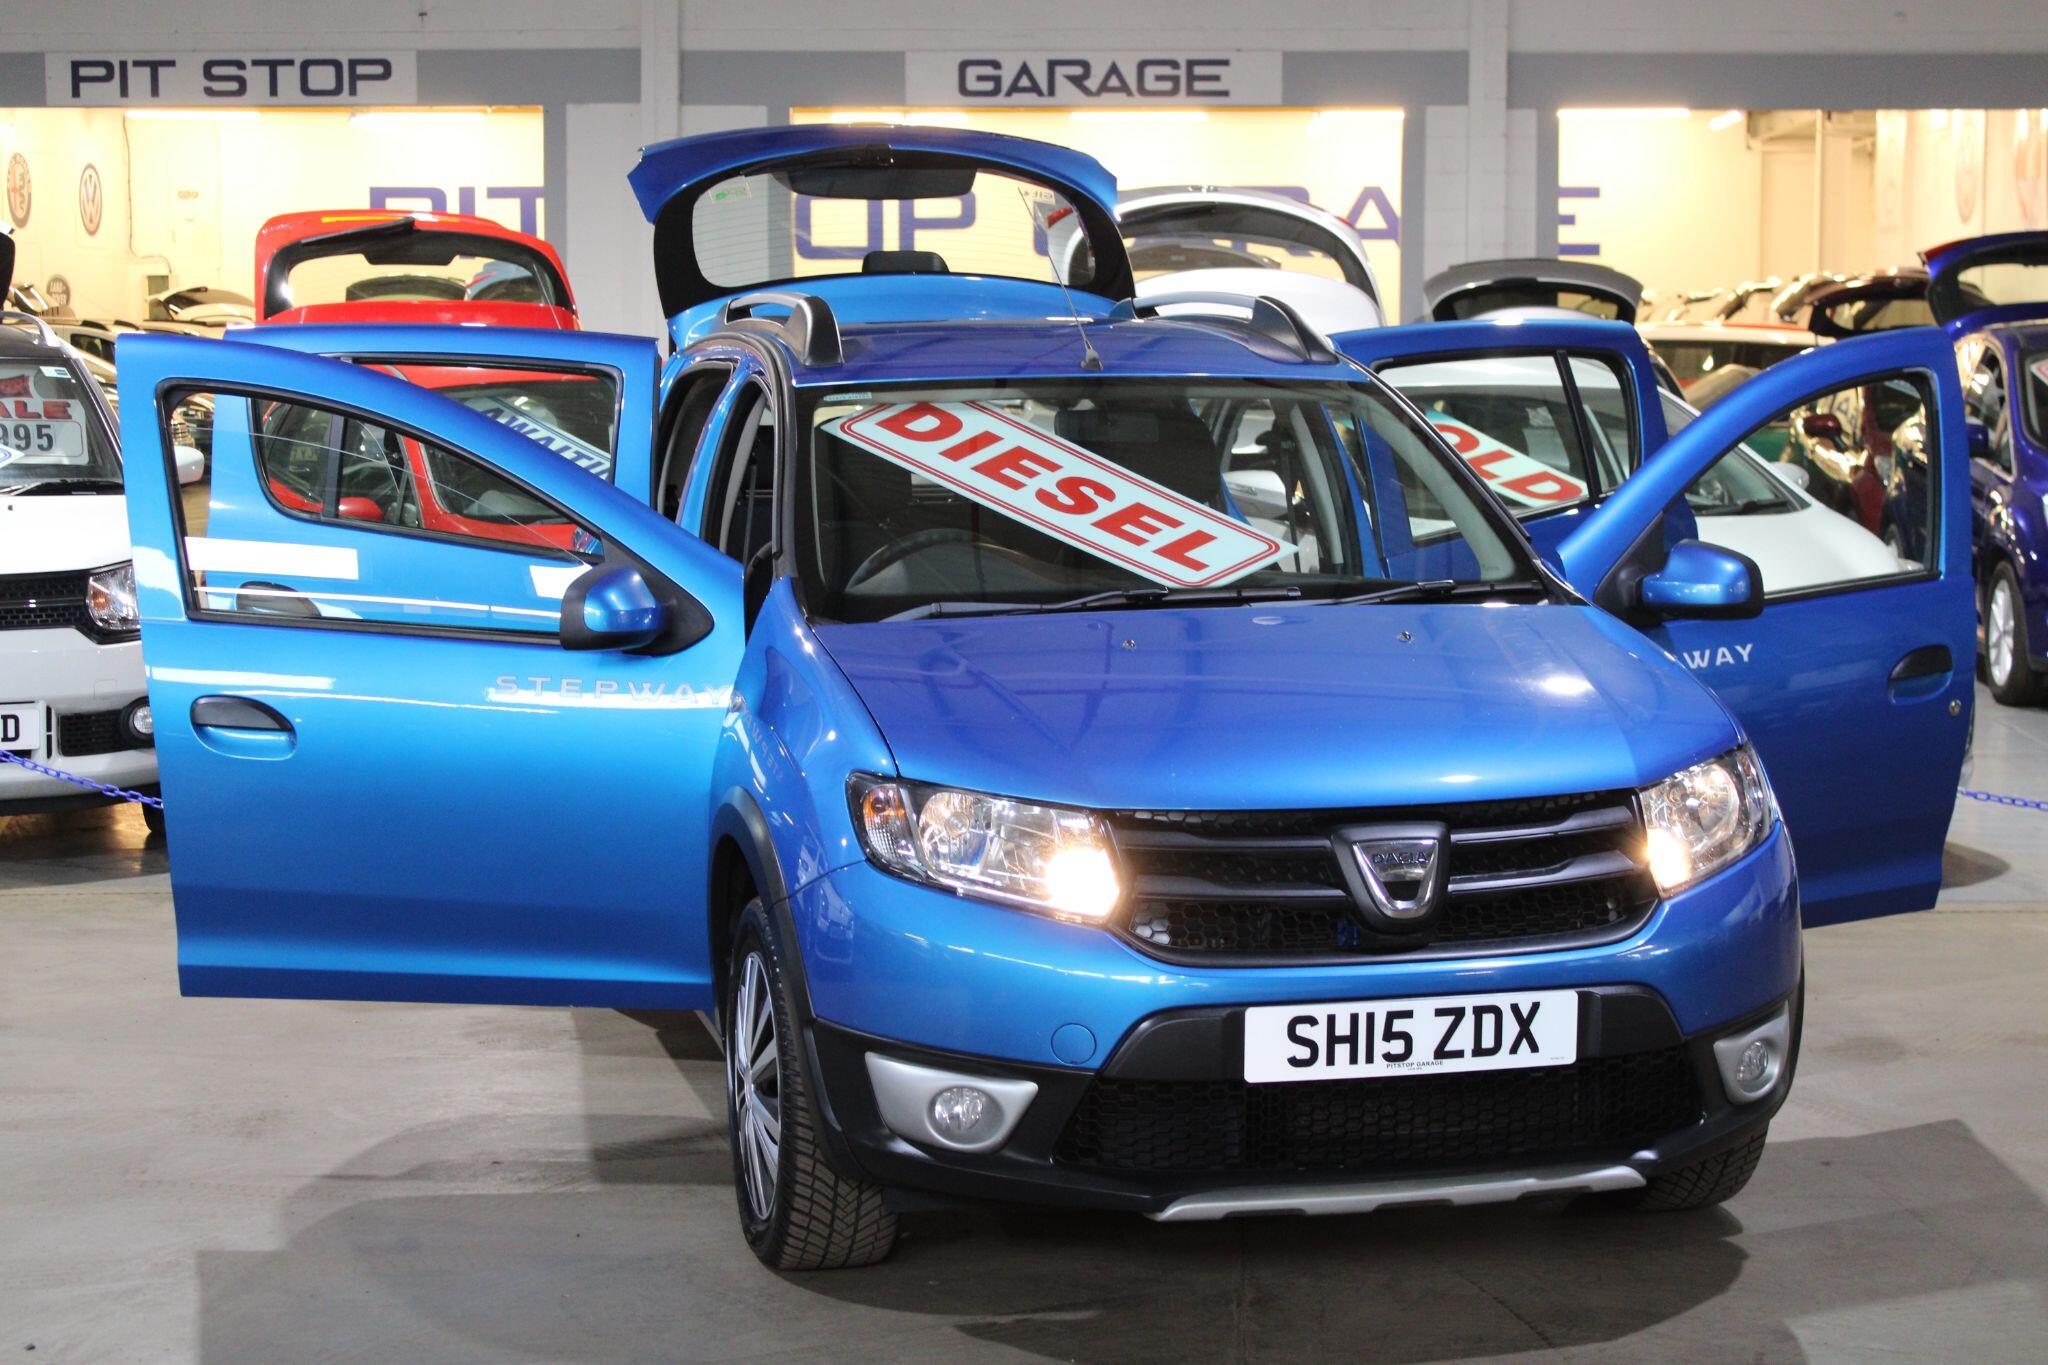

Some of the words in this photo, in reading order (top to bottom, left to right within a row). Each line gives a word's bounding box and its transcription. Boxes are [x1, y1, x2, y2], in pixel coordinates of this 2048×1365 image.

[71, 60, 176, 98] PIT
[203, 59, 392, 97] STOP
[958, 59, 1230, 97] GARAGE
[875, 402, 1217, 572] DIESEL
[1683, 643, 1753, 669] WAY
[495, 675, 729, 705] STEPWAY
[1433, 1001, 1542, 1060] ZDX
